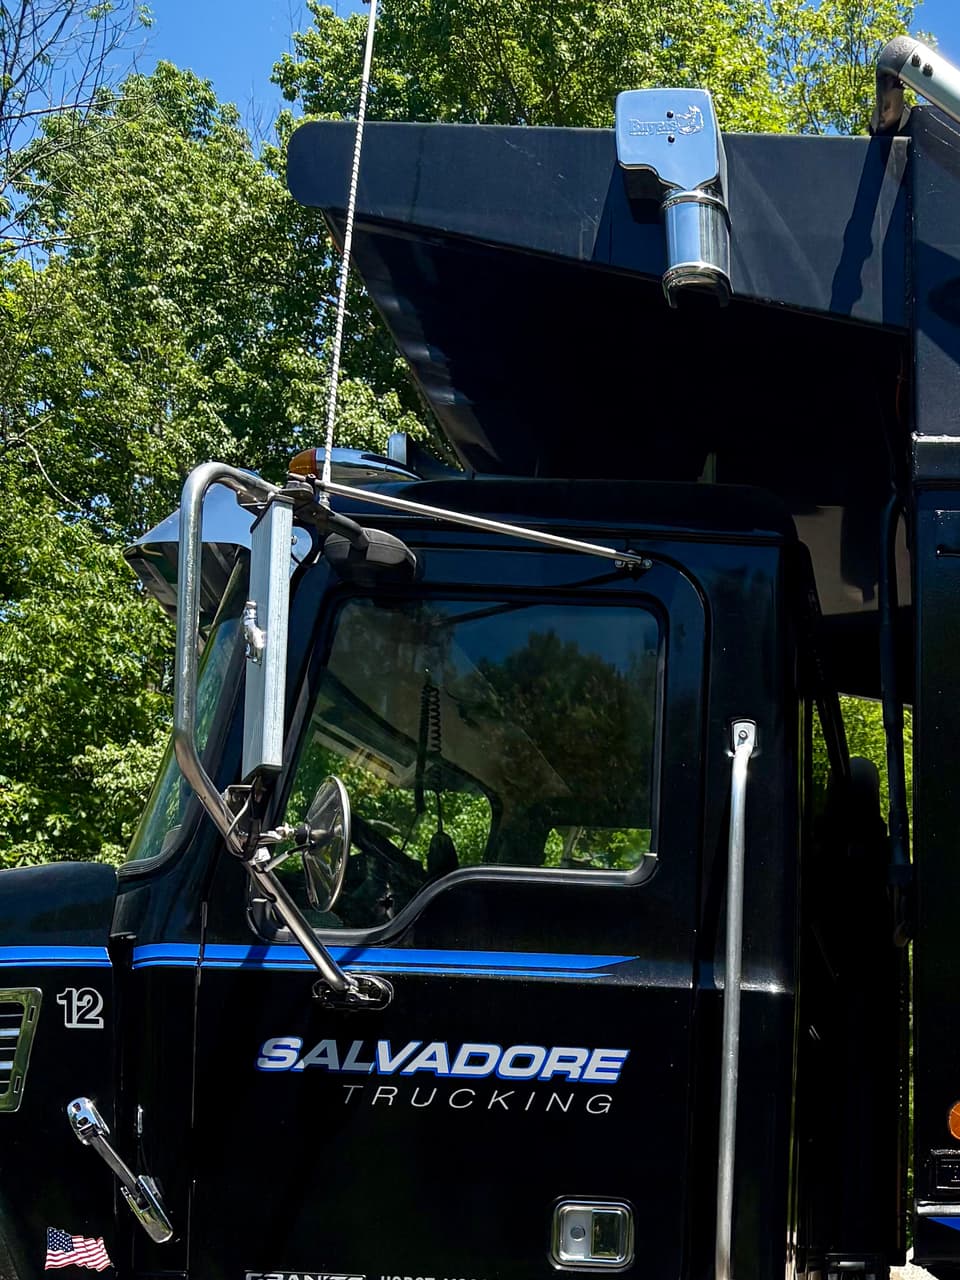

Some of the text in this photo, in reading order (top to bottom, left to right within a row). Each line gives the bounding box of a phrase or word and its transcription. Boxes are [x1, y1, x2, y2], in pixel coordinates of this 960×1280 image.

[56, 987, 104, 1029] 12
[256, 1036, 630, 1083] SALVADORE
[342, 1085, 613, 1114] TRUCKING
